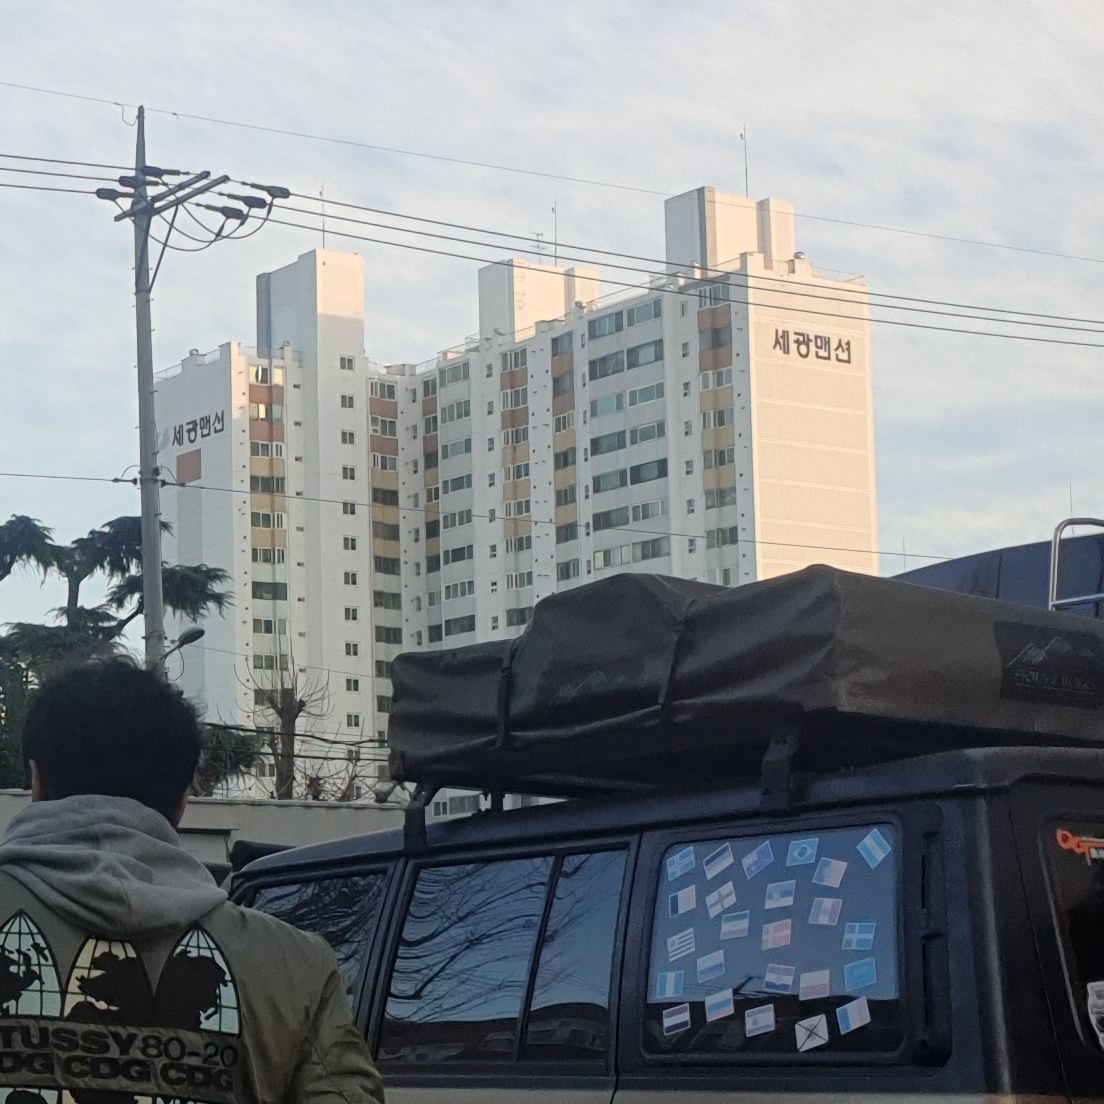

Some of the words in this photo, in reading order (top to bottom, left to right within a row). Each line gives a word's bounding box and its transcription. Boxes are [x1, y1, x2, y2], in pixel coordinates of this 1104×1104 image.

[772, 328, 852, 364] 세광맨션
[171, 409, 225, 446] 세광맨션
[141, 1034, 239, 1068] 80-20
[63, 1055, 151, 1083] CDG
[159, 1061, 235, 1092] CDG
